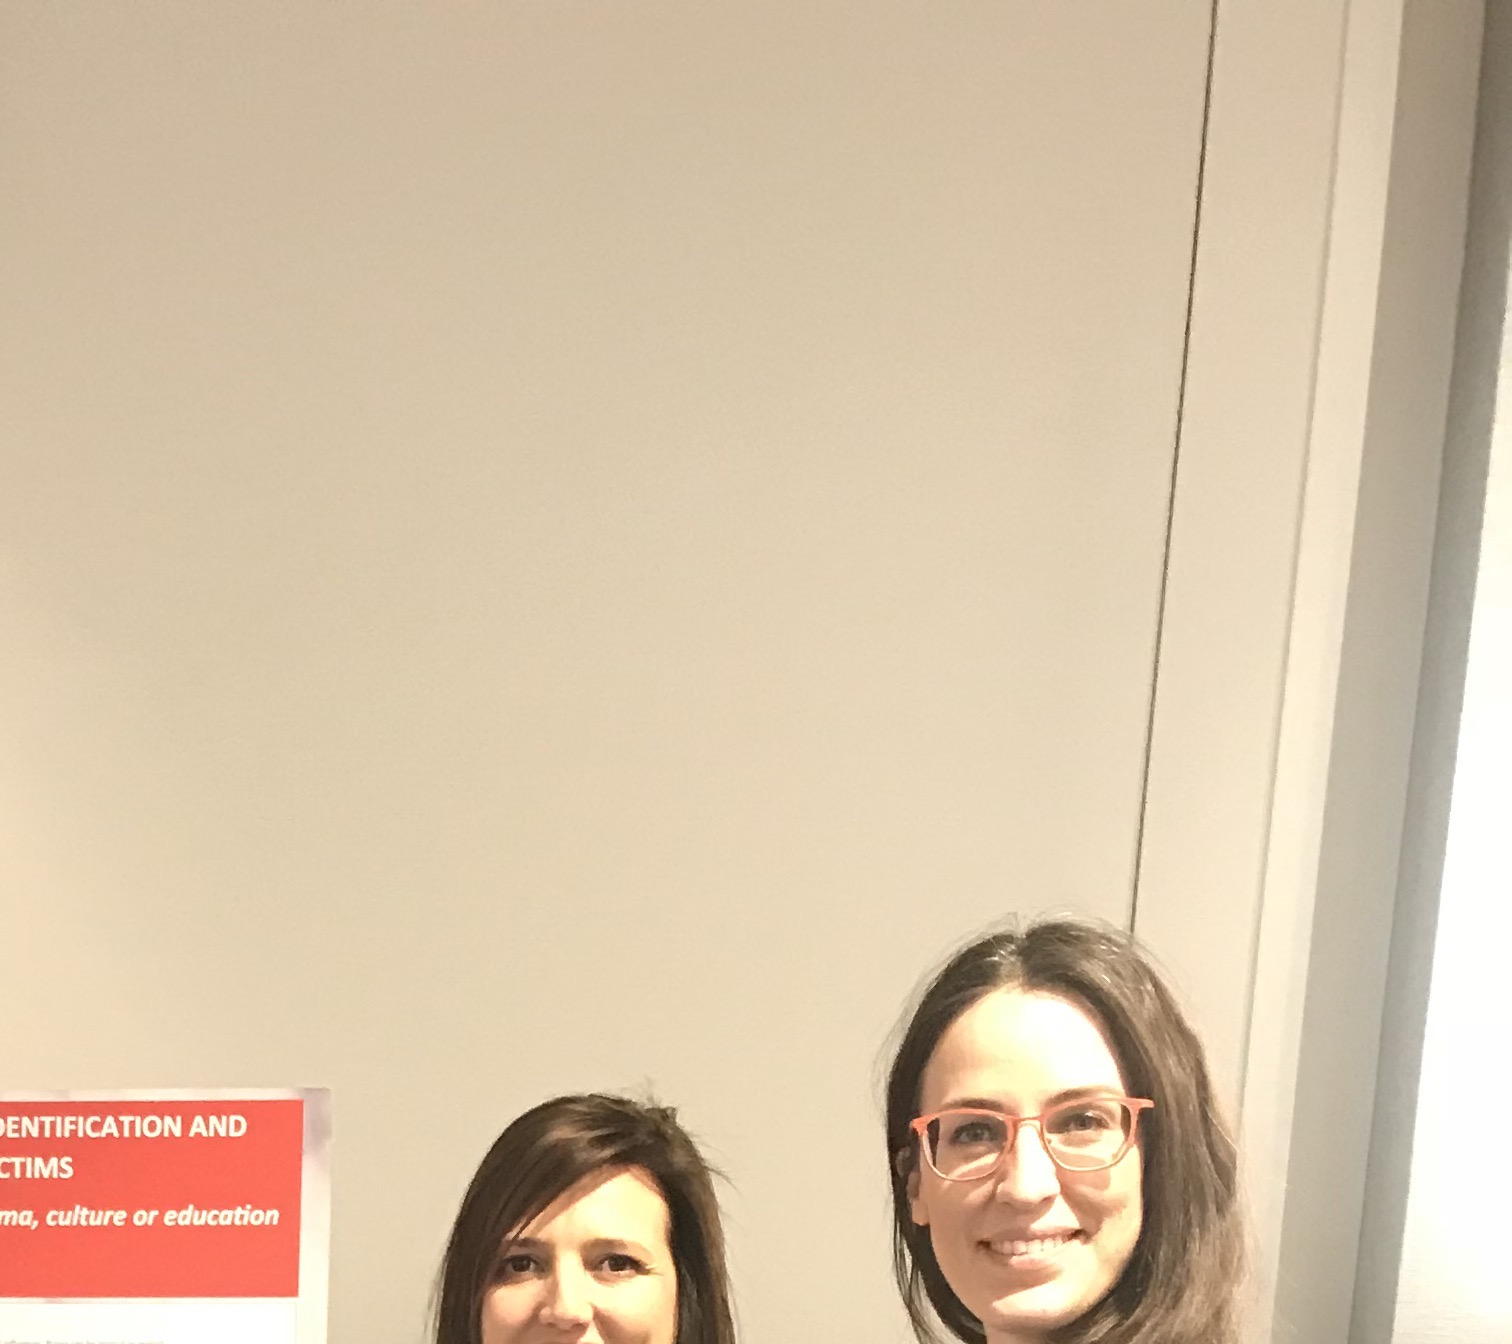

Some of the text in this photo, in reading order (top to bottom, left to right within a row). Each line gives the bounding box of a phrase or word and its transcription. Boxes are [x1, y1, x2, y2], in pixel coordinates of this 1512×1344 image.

[188, 1114, 247, 1137] AND
[45, 1204, 127, 1226] culture
[132, 1209, 159, 1226] or
[163, 1203, 280, 1226] education
